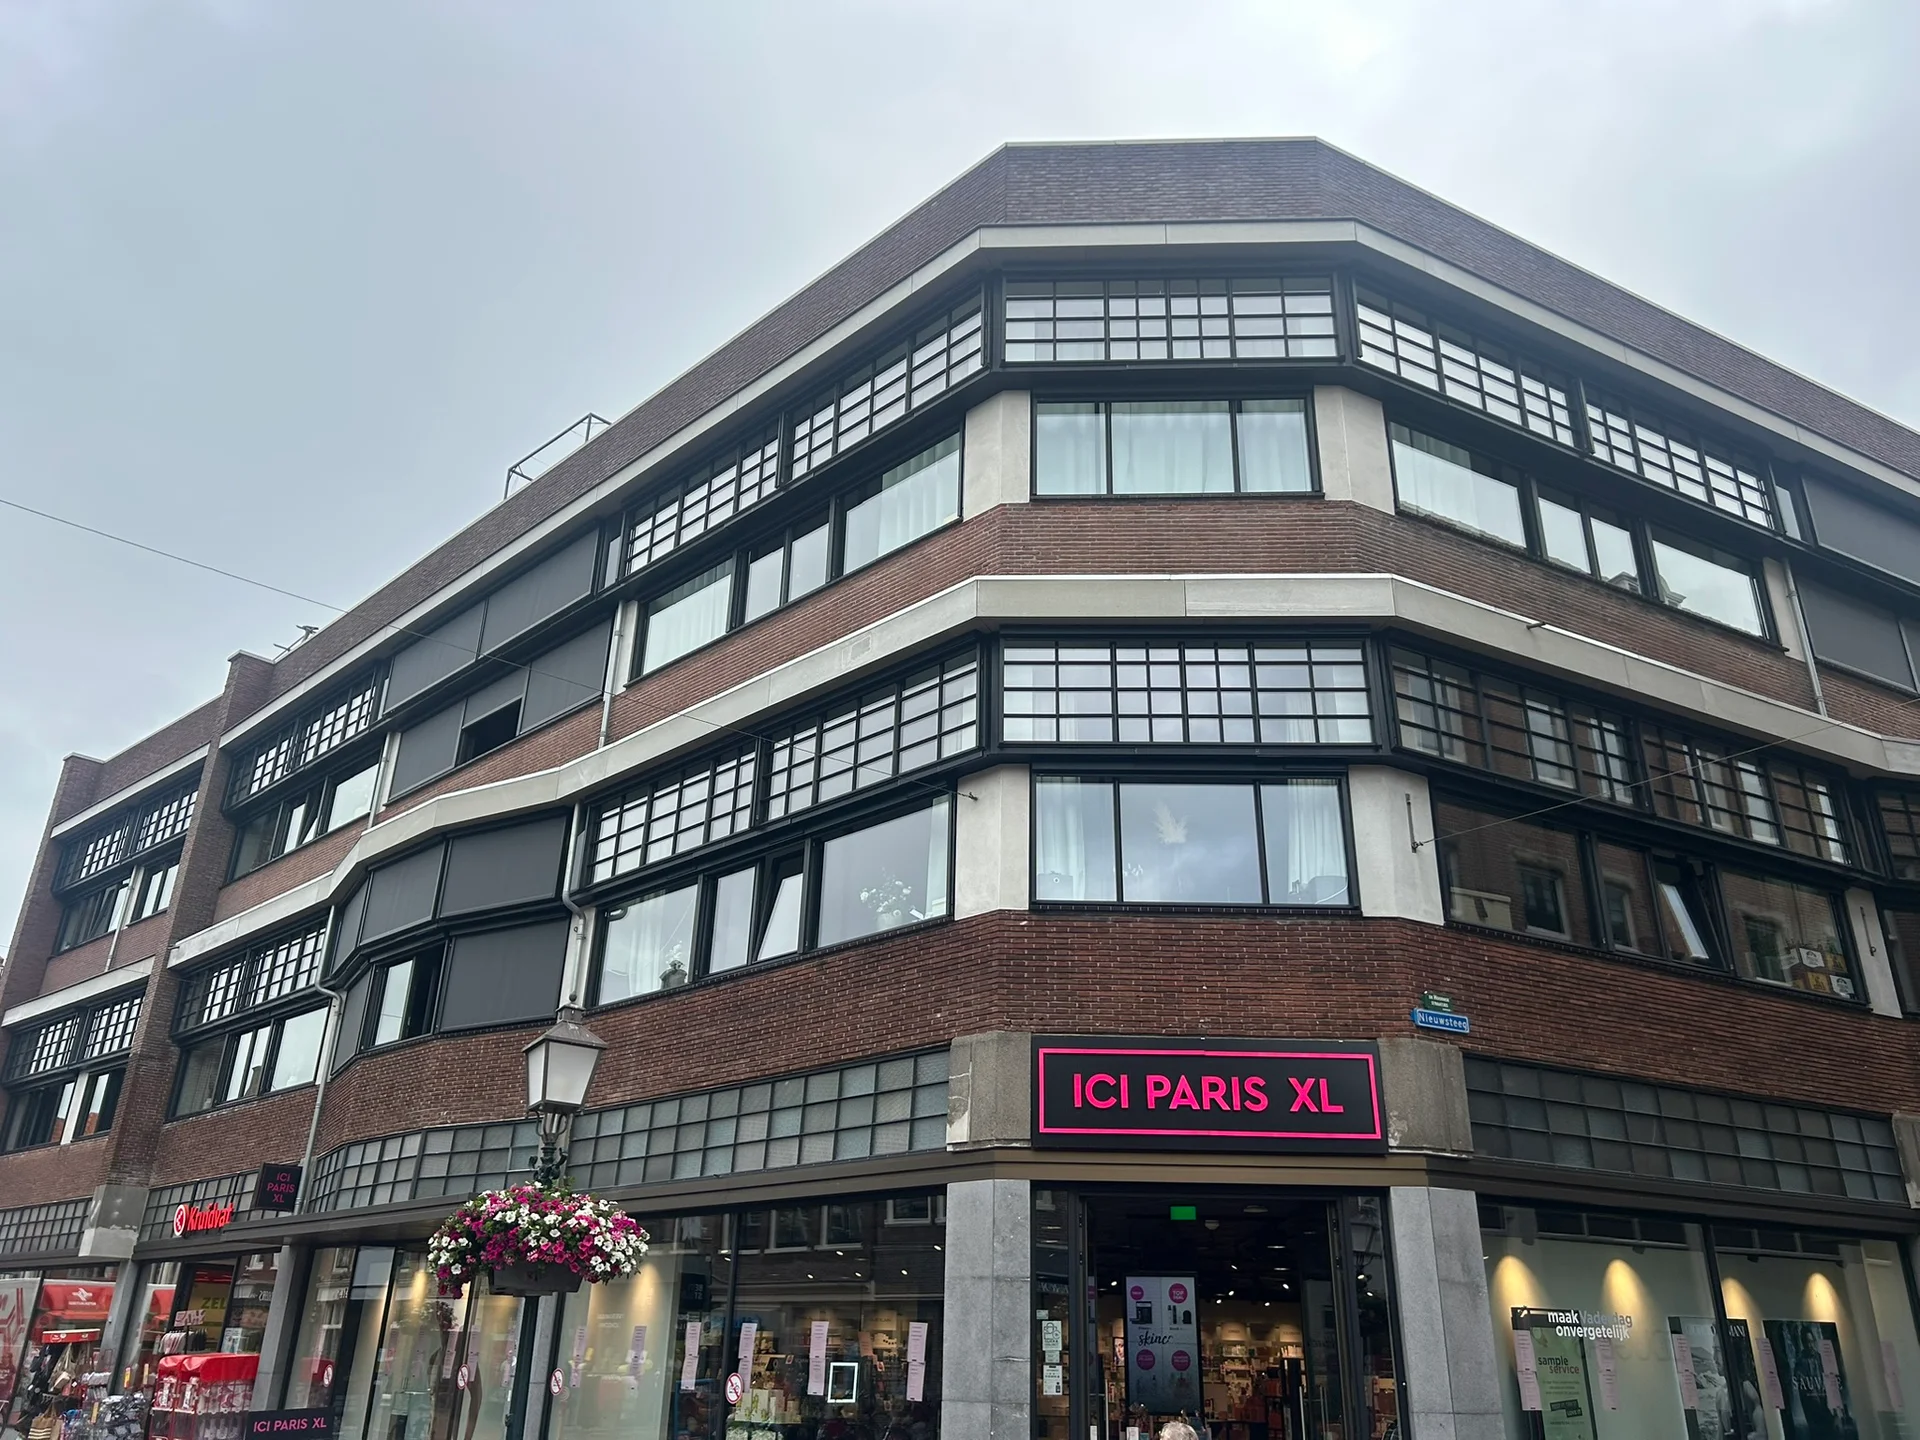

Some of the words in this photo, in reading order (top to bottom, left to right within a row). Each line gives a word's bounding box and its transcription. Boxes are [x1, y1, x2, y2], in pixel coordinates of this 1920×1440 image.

[1418, 1012, 1467, 1031] Nieuwsteeg
[1073, 1073, 1129, 1109] ICI
[1146, 1075, 1268, 1112] PARIS
[1289, 1077, 1344, 1113] XL
[276, 1172, 291, 1182] ICI
[266, 1182, 295, 1193] PARIS
[272, 1193, 285, 1203] XL
[186, 1202, 235, 1231] Kruidvat
[1547, 1310, 1580, 1324] maak
[1555, 1324, 1631, 1341] onvergetelijk
[1538, 1356, 1569, 1366] sample
[1549, 1364, 1580, 1374] service
[253, 1421, 271, 1433] ICI
[273, 1418, 308, 1432] PARIS
[311, 1417, 327, 1429] XL
